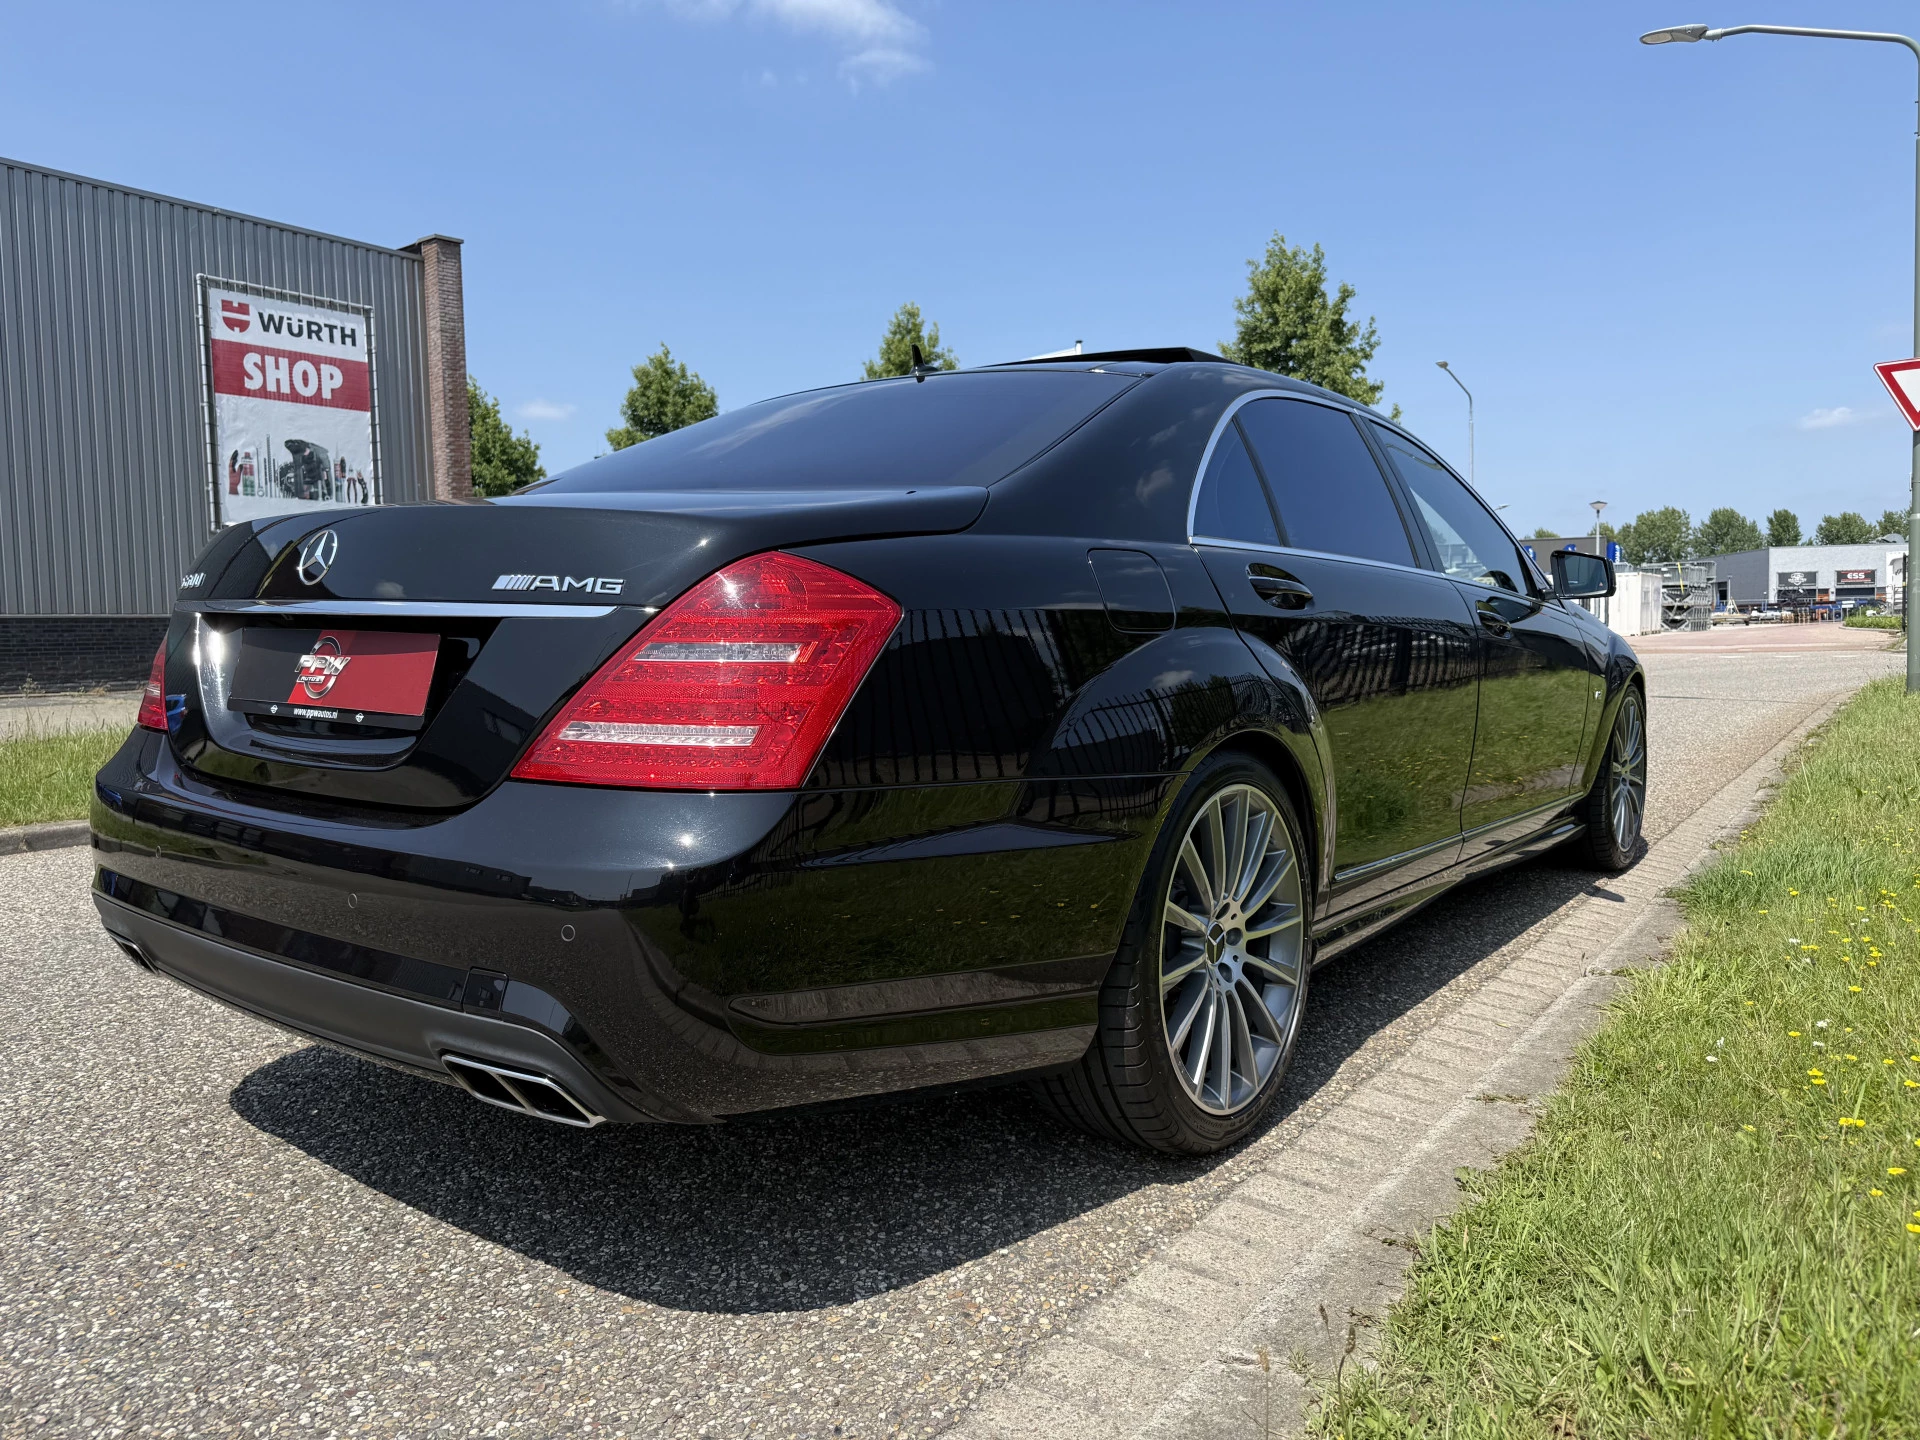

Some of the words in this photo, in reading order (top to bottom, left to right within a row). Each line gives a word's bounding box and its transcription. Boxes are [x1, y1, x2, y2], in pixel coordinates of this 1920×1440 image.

[258, 312, 357, 347] WÜRTH
[243, 352, 344, 400] SHOP
[529, 575, 625, 595] AMG
[294, 654, 351, 675] PPW
[293, 708, 338, 719] www.ppwautos.nl
